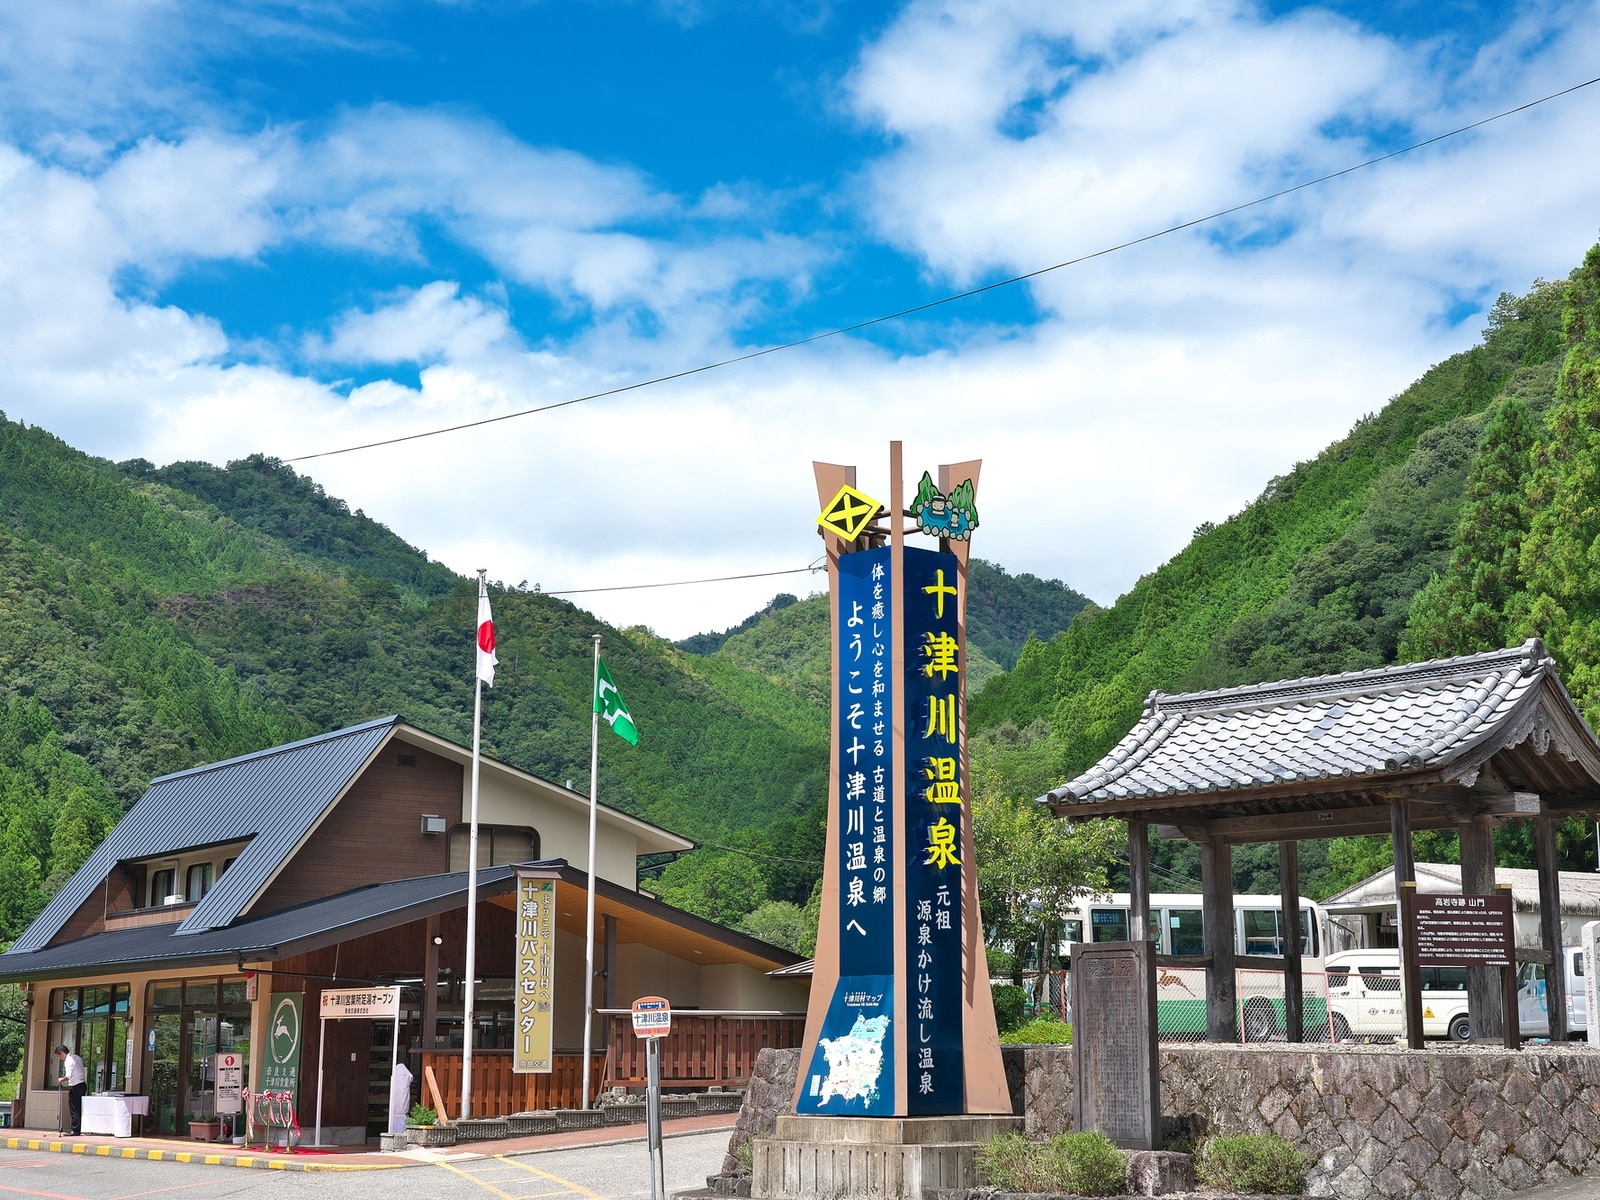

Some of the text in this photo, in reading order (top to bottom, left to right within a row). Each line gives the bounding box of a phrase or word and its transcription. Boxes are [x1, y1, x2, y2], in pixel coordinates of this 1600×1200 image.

[846, 600, 867, 936] ようこそ十津川温泉へ
[872, 563, 886, 904] 体を癒し心を和ませる 古道と温泉の郷
[924, 569, 961, 870] 十津川温泉
[541, 894, 550, 939] ようこそ
[935, 885, 952, 930] 元祖
[1435, 897, 1485, 907] 高岩寺跡 山門
[520, 881, 539, 1053] 十津川バスセンター
[634, 1012, 669, 1023] 十津川温泉
[917, 900, 933, 1095] 源泉かけ流し温泉
[266, 1066, 296, 1077] 奈良交通
